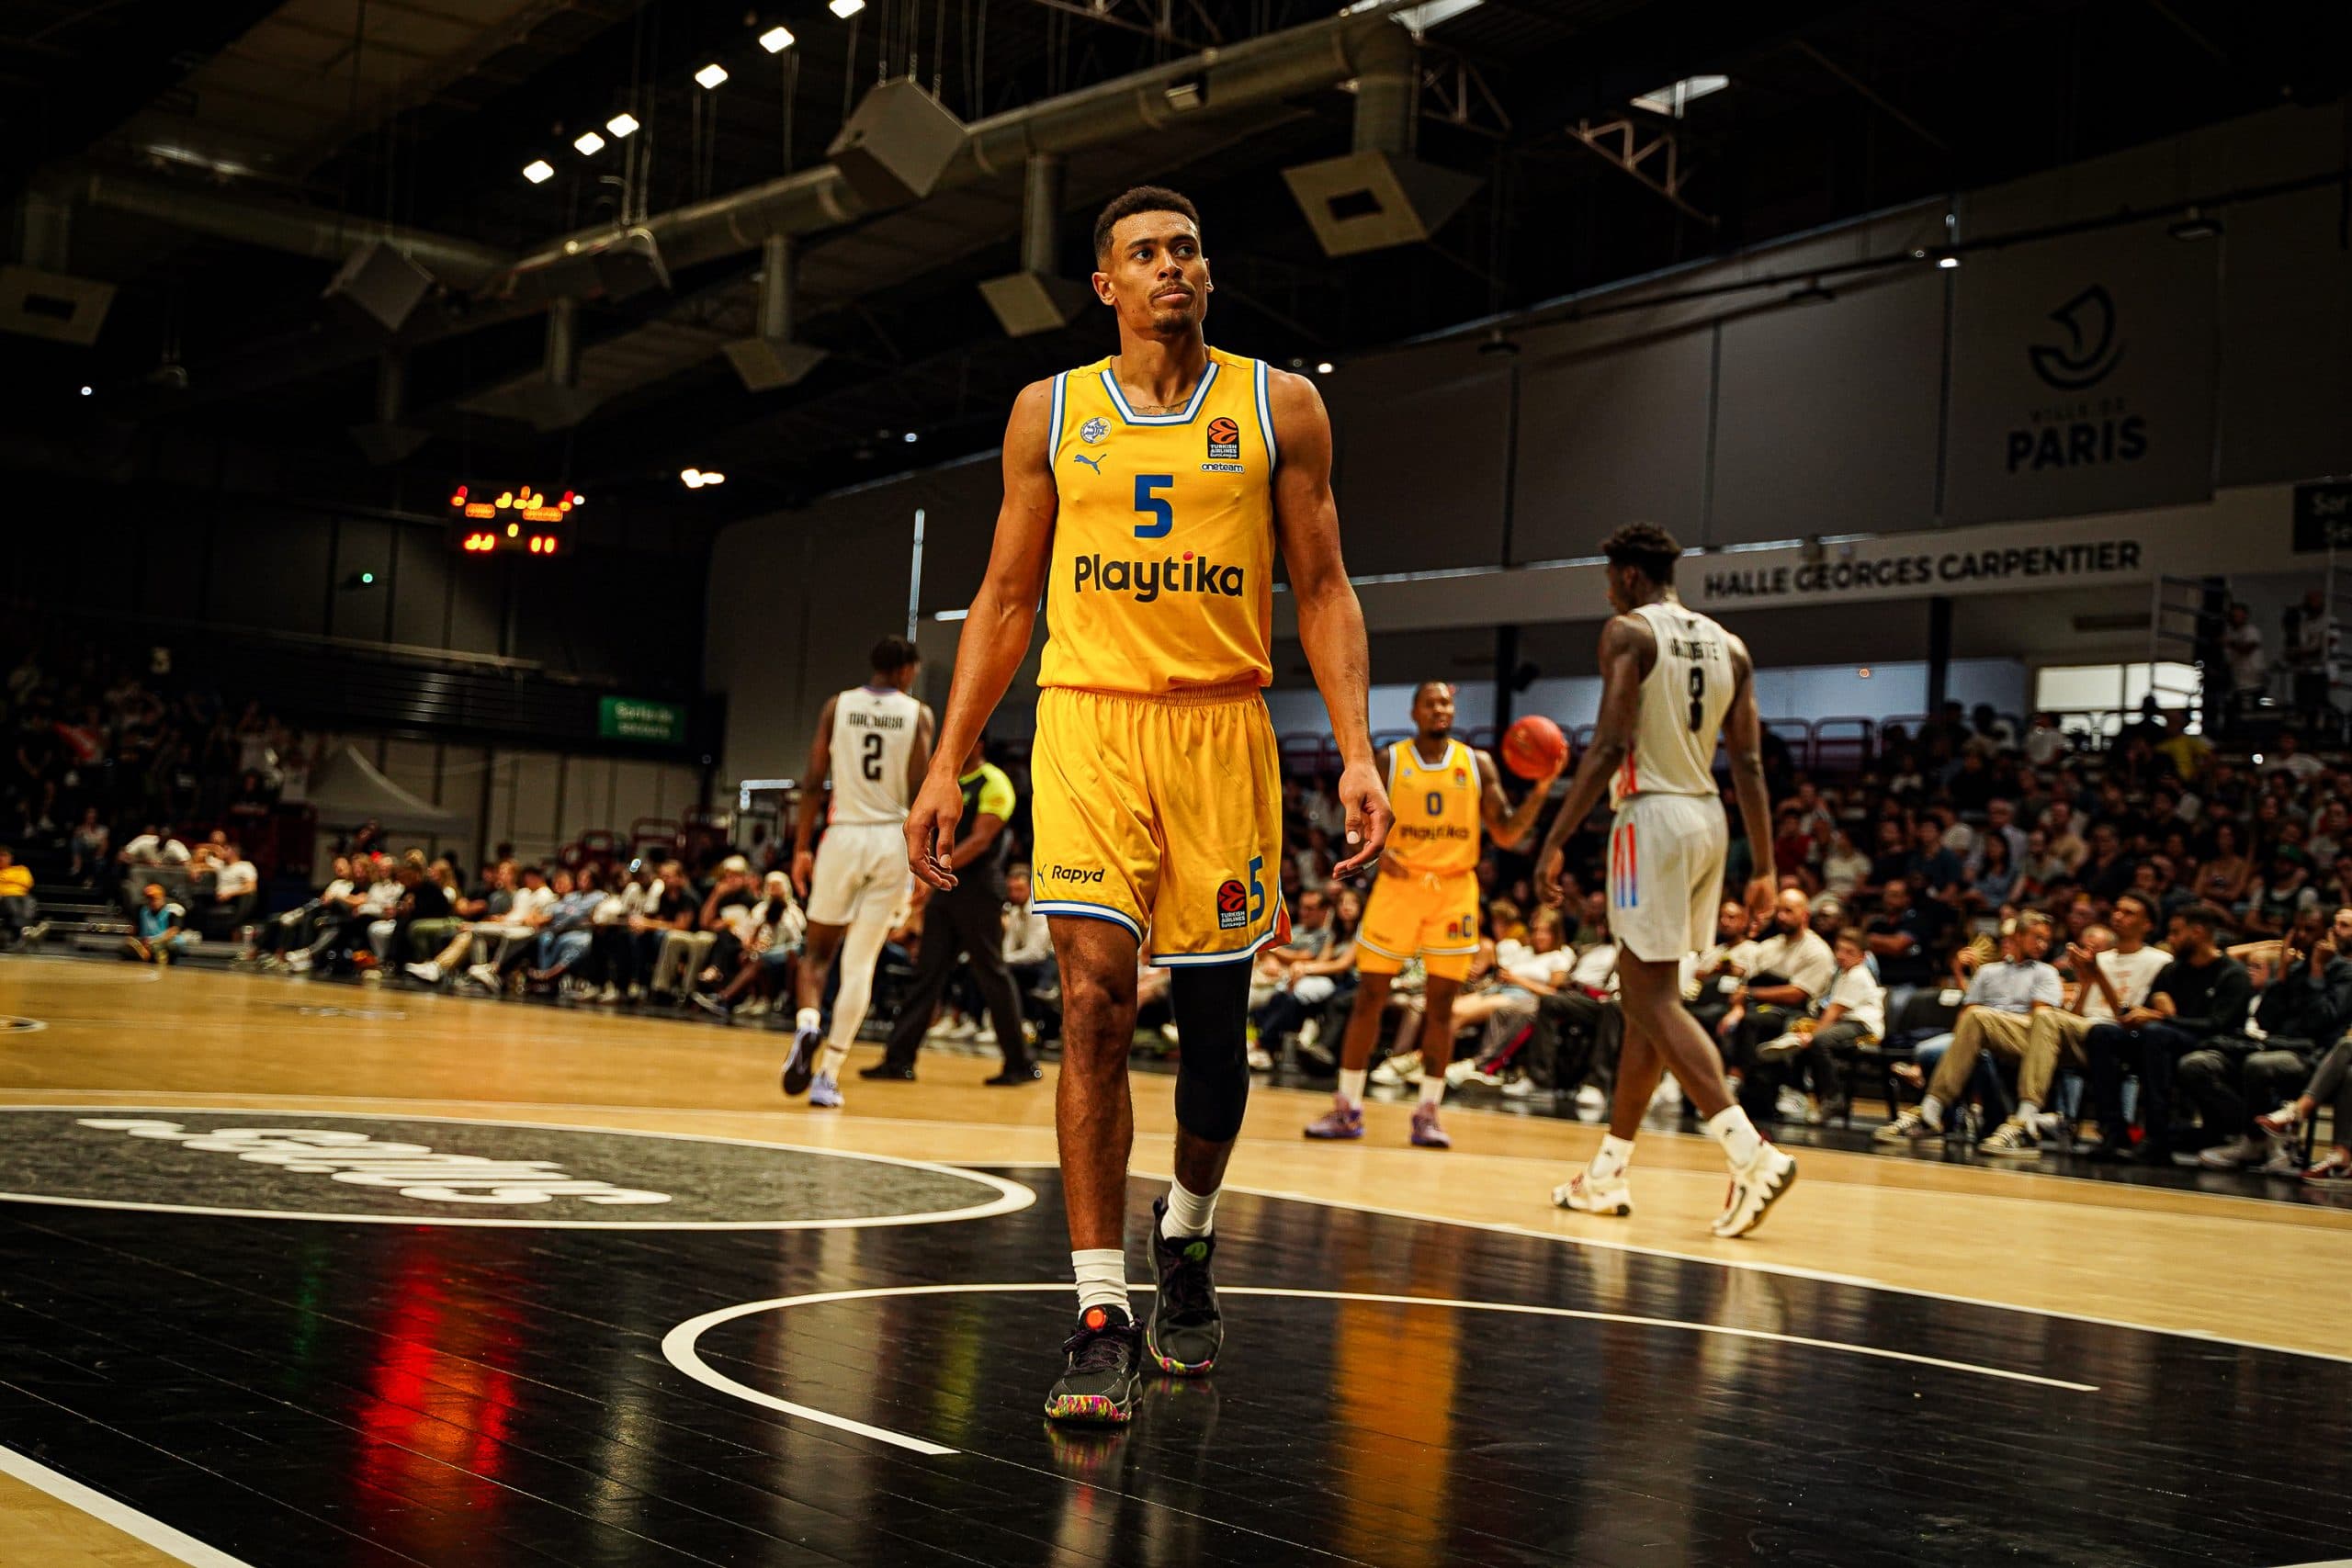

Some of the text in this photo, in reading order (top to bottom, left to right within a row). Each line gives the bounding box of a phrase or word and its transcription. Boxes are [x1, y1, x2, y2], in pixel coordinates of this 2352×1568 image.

[1201, 462, 1244, 473] oneteam
[2007, 416, 2147, 473] PARIS
[1135, 475, 1173, 538] 5
[1074, 551, 1244, 603] Playtika
[1704, 541, 2141, 600] HALLE GEORGES CARPENTIER
[864, 733, 883, 781] 2
[1427, 792, 1442, 816] 0
[1052, 865, 1105, 884] Rapyd
[1249, 855, 1265, 922] 5
